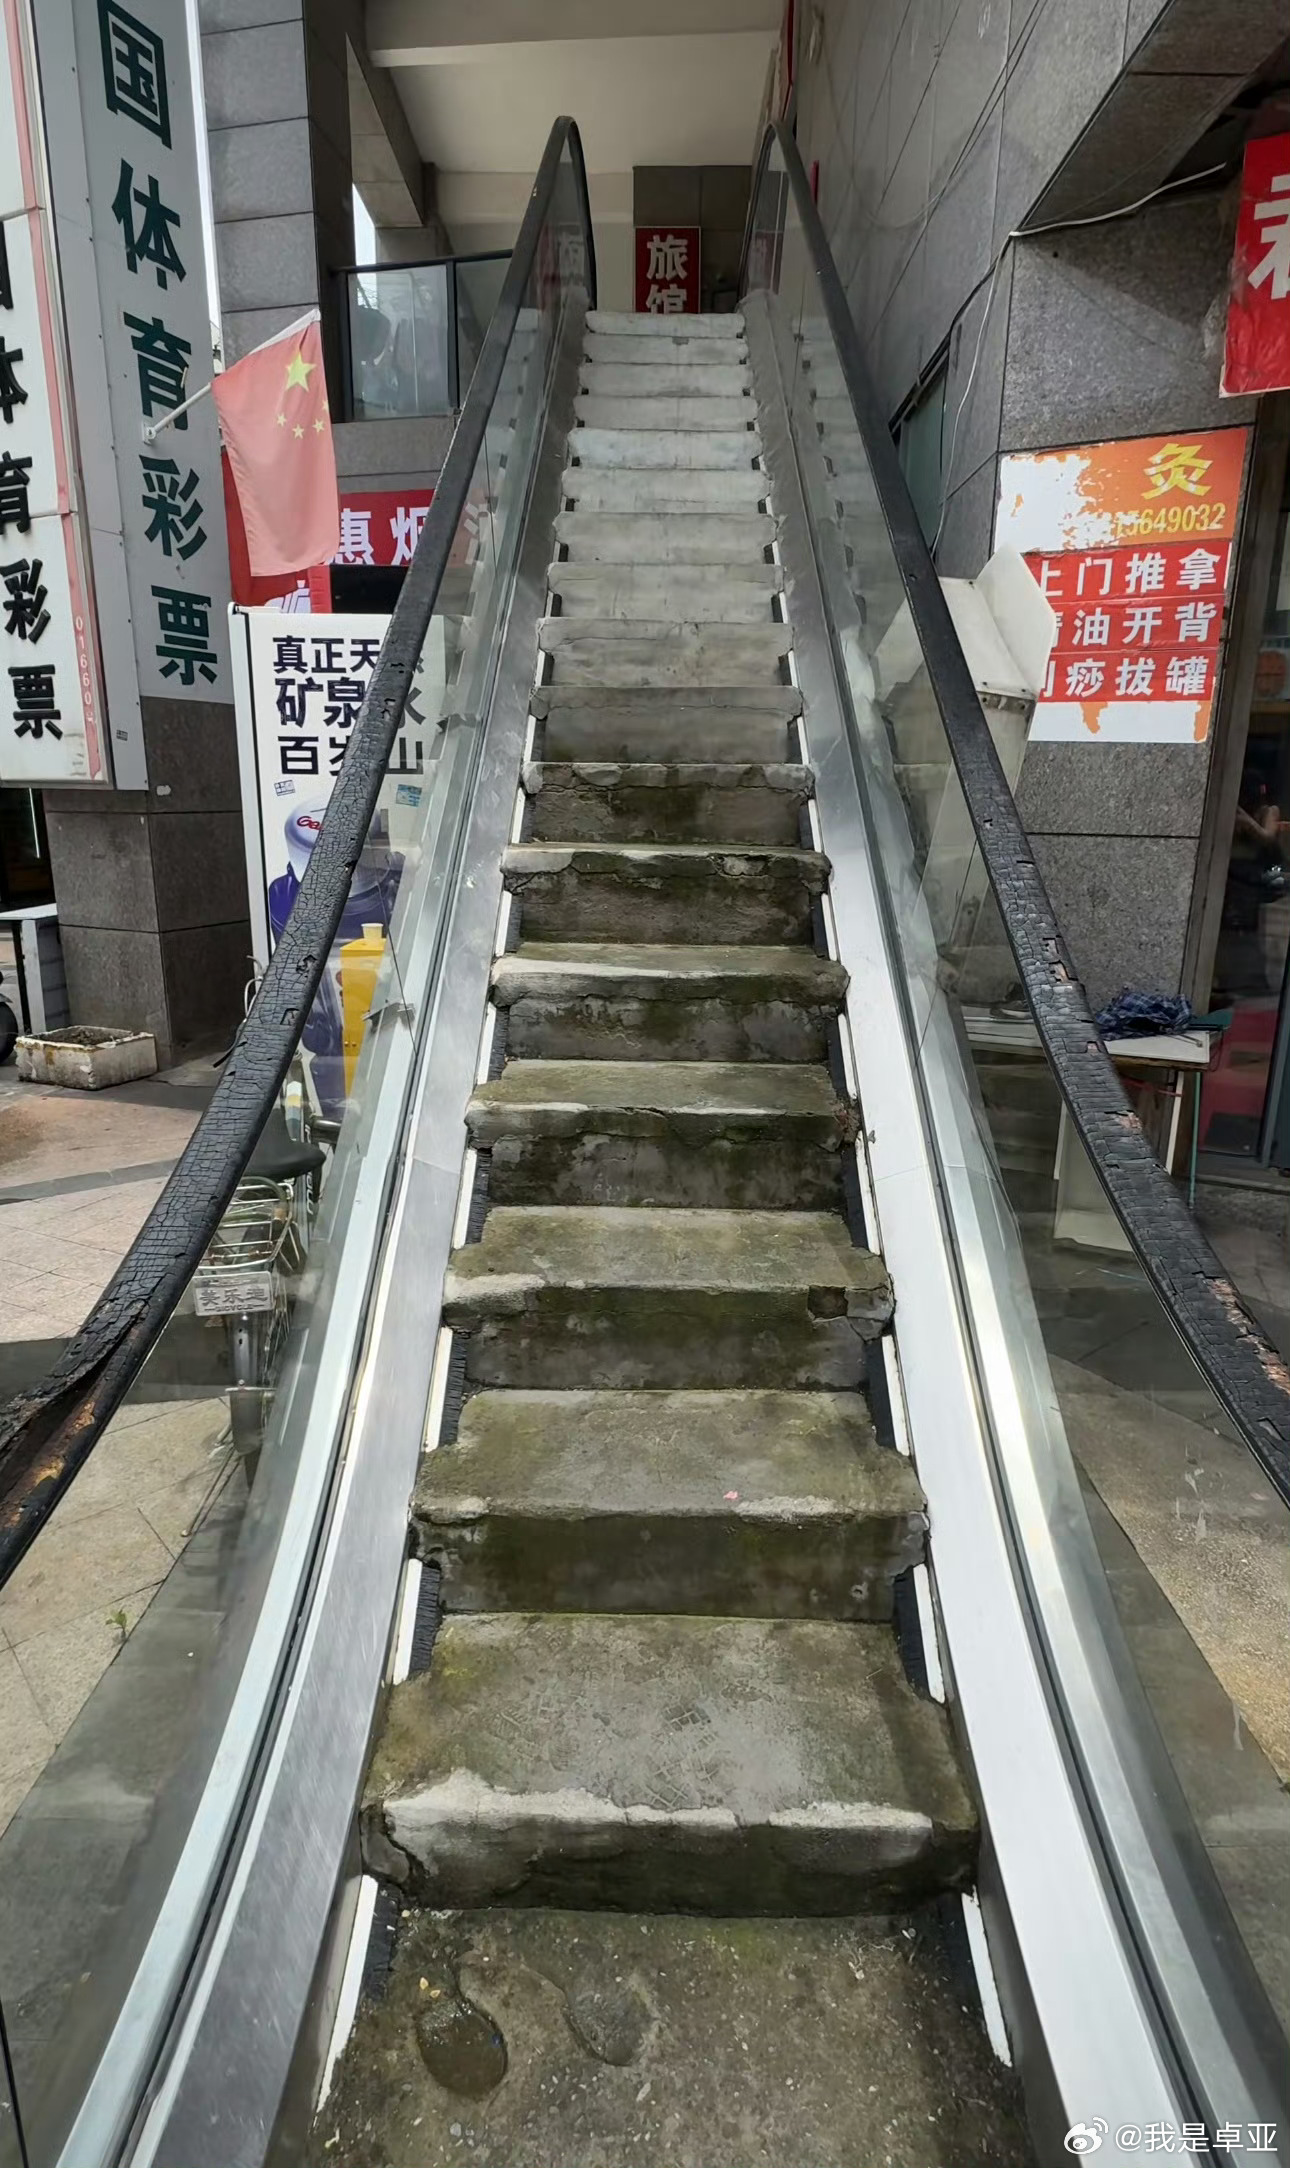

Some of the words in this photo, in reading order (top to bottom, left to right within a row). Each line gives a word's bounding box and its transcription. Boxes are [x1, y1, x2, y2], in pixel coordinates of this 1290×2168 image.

[646, 234, 688, 314] 旅馆
[97, 0, 218, 685] 国体育彩票
[0, 221, 63, 740] 体育彩票
[1142, 443, 1214, 500] 灸
[1039, 548, 1221, 597] 上门推拿
[273, 635, 424, 674] 真正天
[1040, 656, 1209, 698] 痧拔罐
